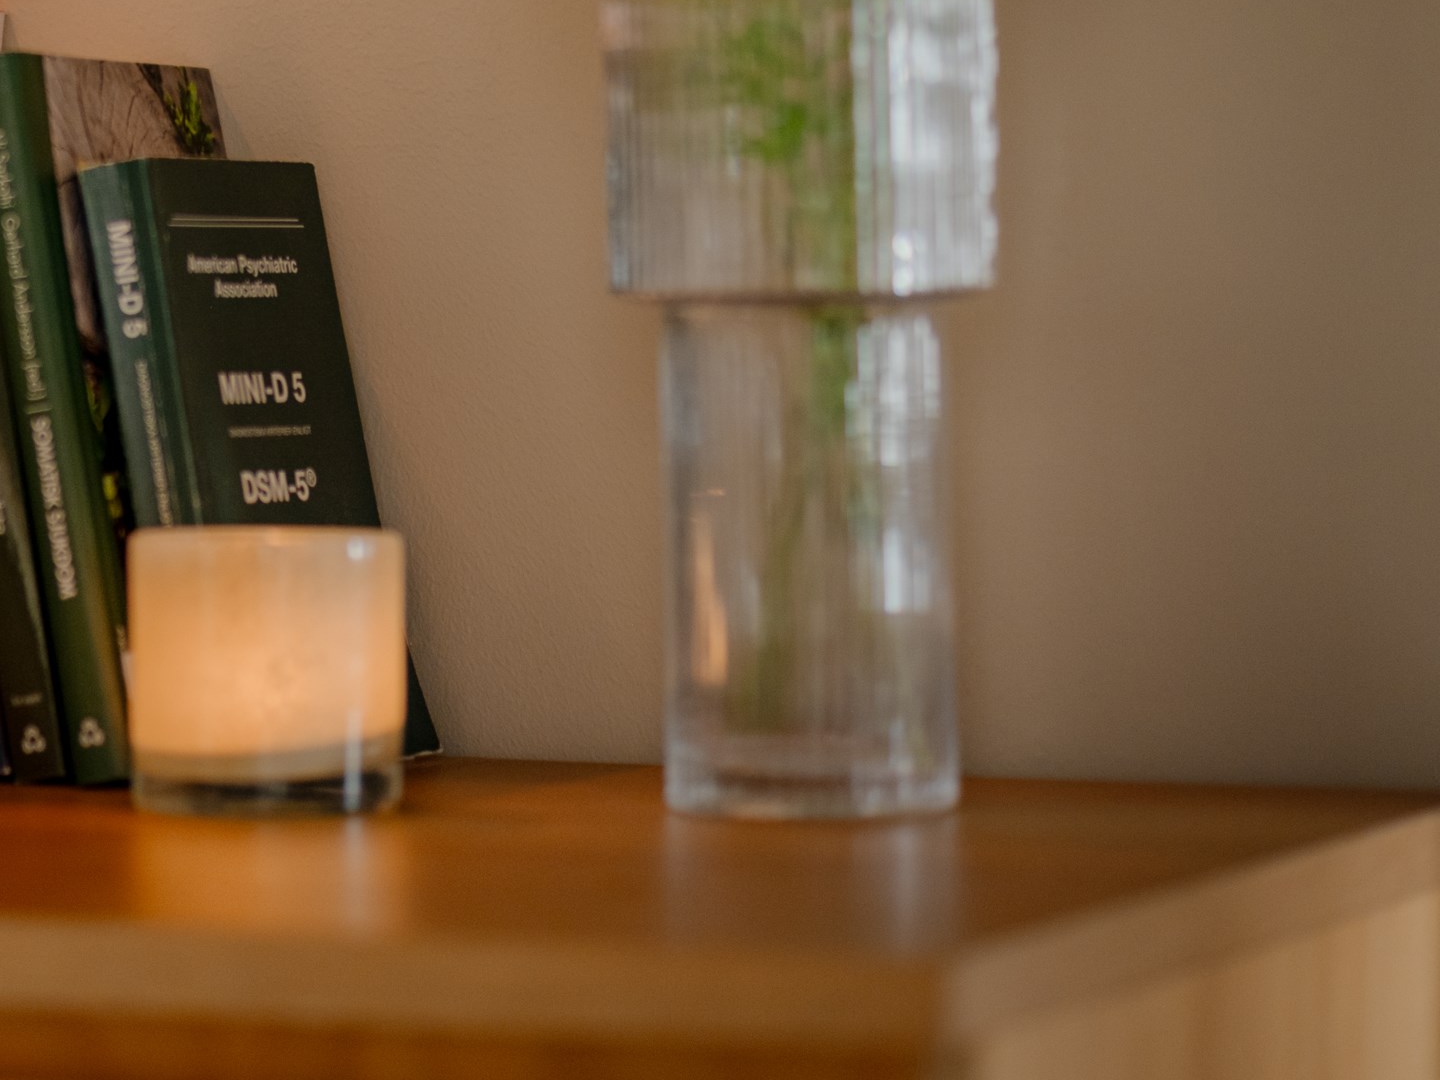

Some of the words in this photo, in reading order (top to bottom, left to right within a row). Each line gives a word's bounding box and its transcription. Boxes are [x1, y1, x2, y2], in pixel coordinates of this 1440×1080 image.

[106, 219, 143, 316] MINI-D
[187, 254, 237, 274] American
[239, 254, 298, 278] Psychiatric
[214, 280, 278, 298] Association
[122, 317, 148, 339] 5
[218, 372, 289, 404] MINI-D
[292, 372, 306, 402] 5
[31, 414, 62, 510] SOMATISK
[46, 508, 81, 601] SJUKDOM
